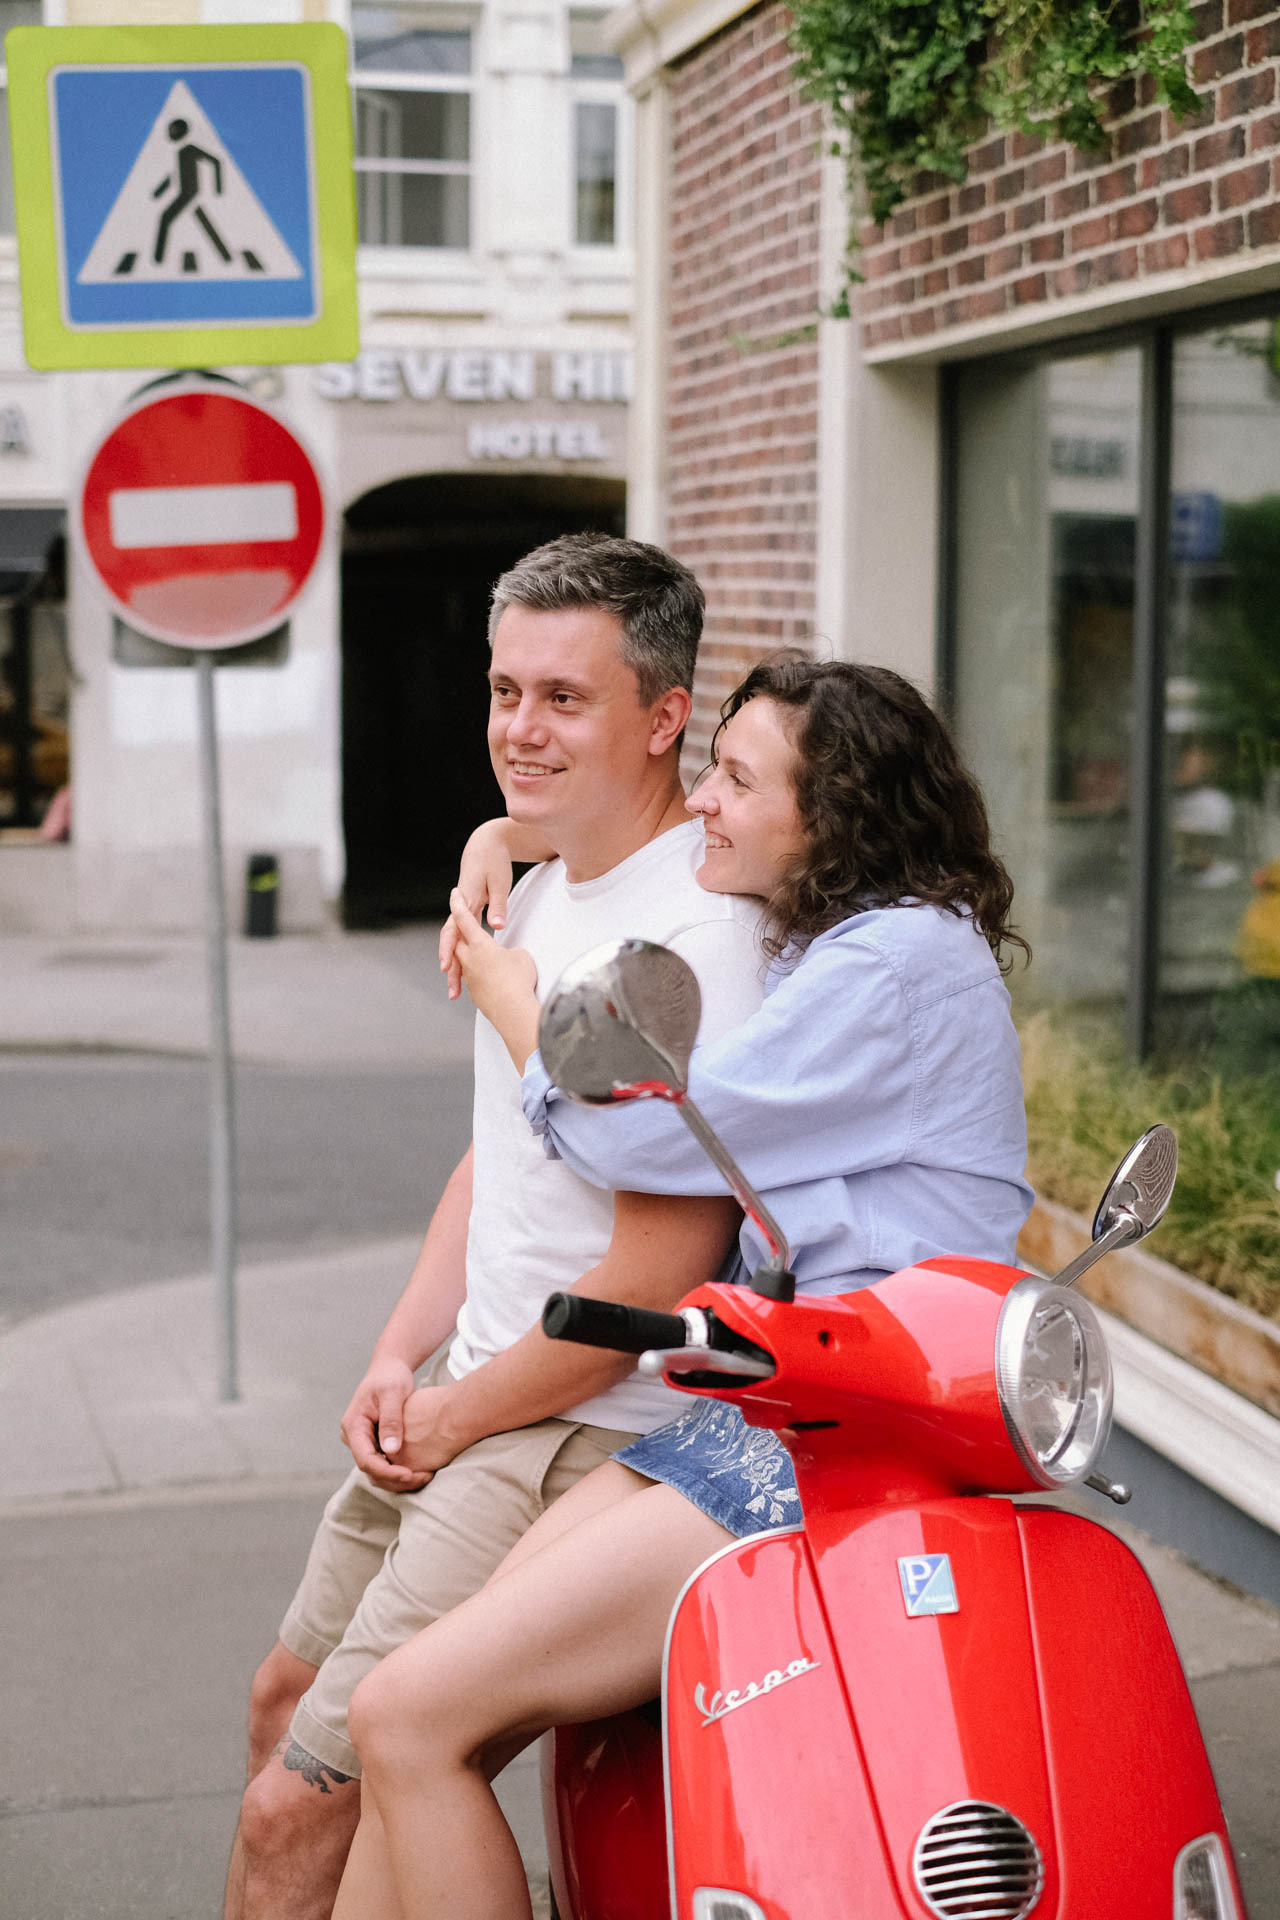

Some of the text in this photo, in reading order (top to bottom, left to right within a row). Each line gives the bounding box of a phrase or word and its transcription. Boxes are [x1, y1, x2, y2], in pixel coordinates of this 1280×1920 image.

[318, 350, 536, 400] SEVEN
[466, 421, 610, 459] HOTEL
[903, 1559, 932, 1596] P
[694, 1657, 822, 1728] Vespa
